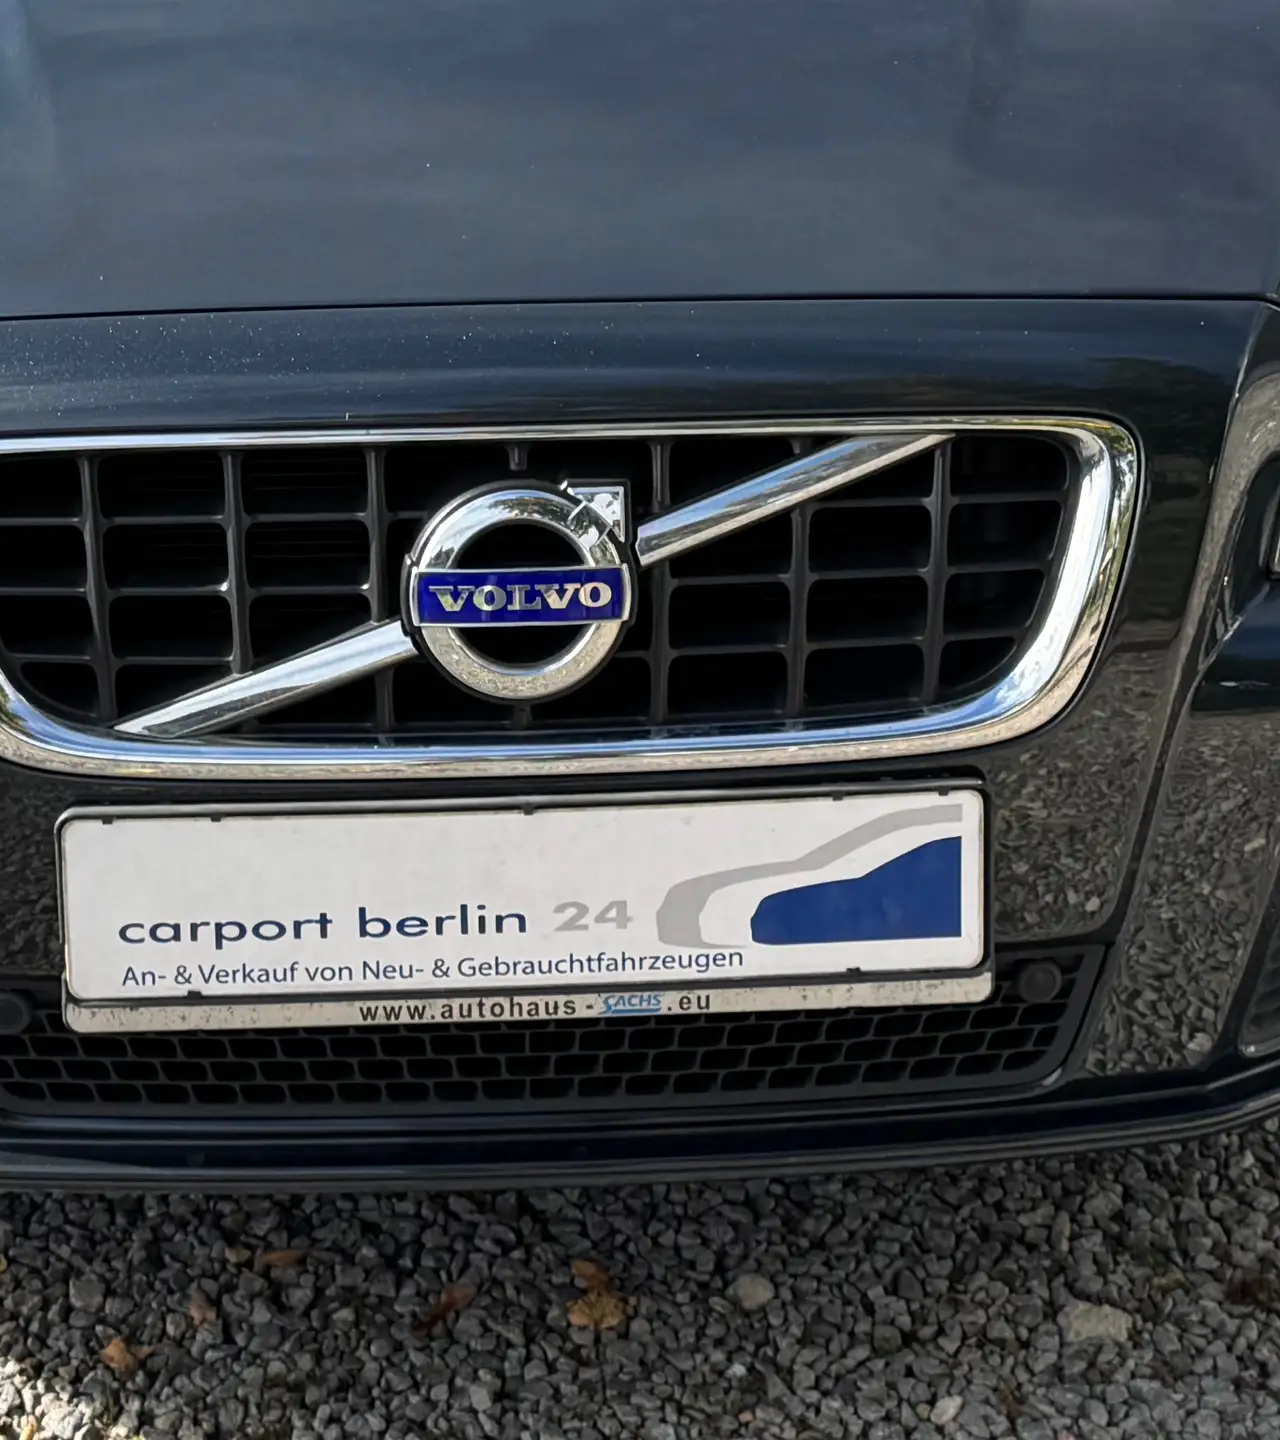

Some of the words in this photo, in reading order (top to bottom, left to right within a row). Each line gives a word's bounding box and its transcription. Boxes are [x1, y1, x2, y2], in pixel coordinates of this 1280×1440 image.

[428, 581, 613, 612] VOLVO
[118, 912, 333, 950] carport
[358, 903, 527, 938] berlin
[552, 900, 633, 932] 24
[122, 966, 167, 987] An-
[174, 964, 193, 986] &
[197, 961, 300, 986] Verkauf
[304, 967, 354, 983] von
[362, 960, 425, 981] Neu-
[431, 958, 451, 979] &
[457, 951, 744, 978] Gebrauchtfahrzeugen
